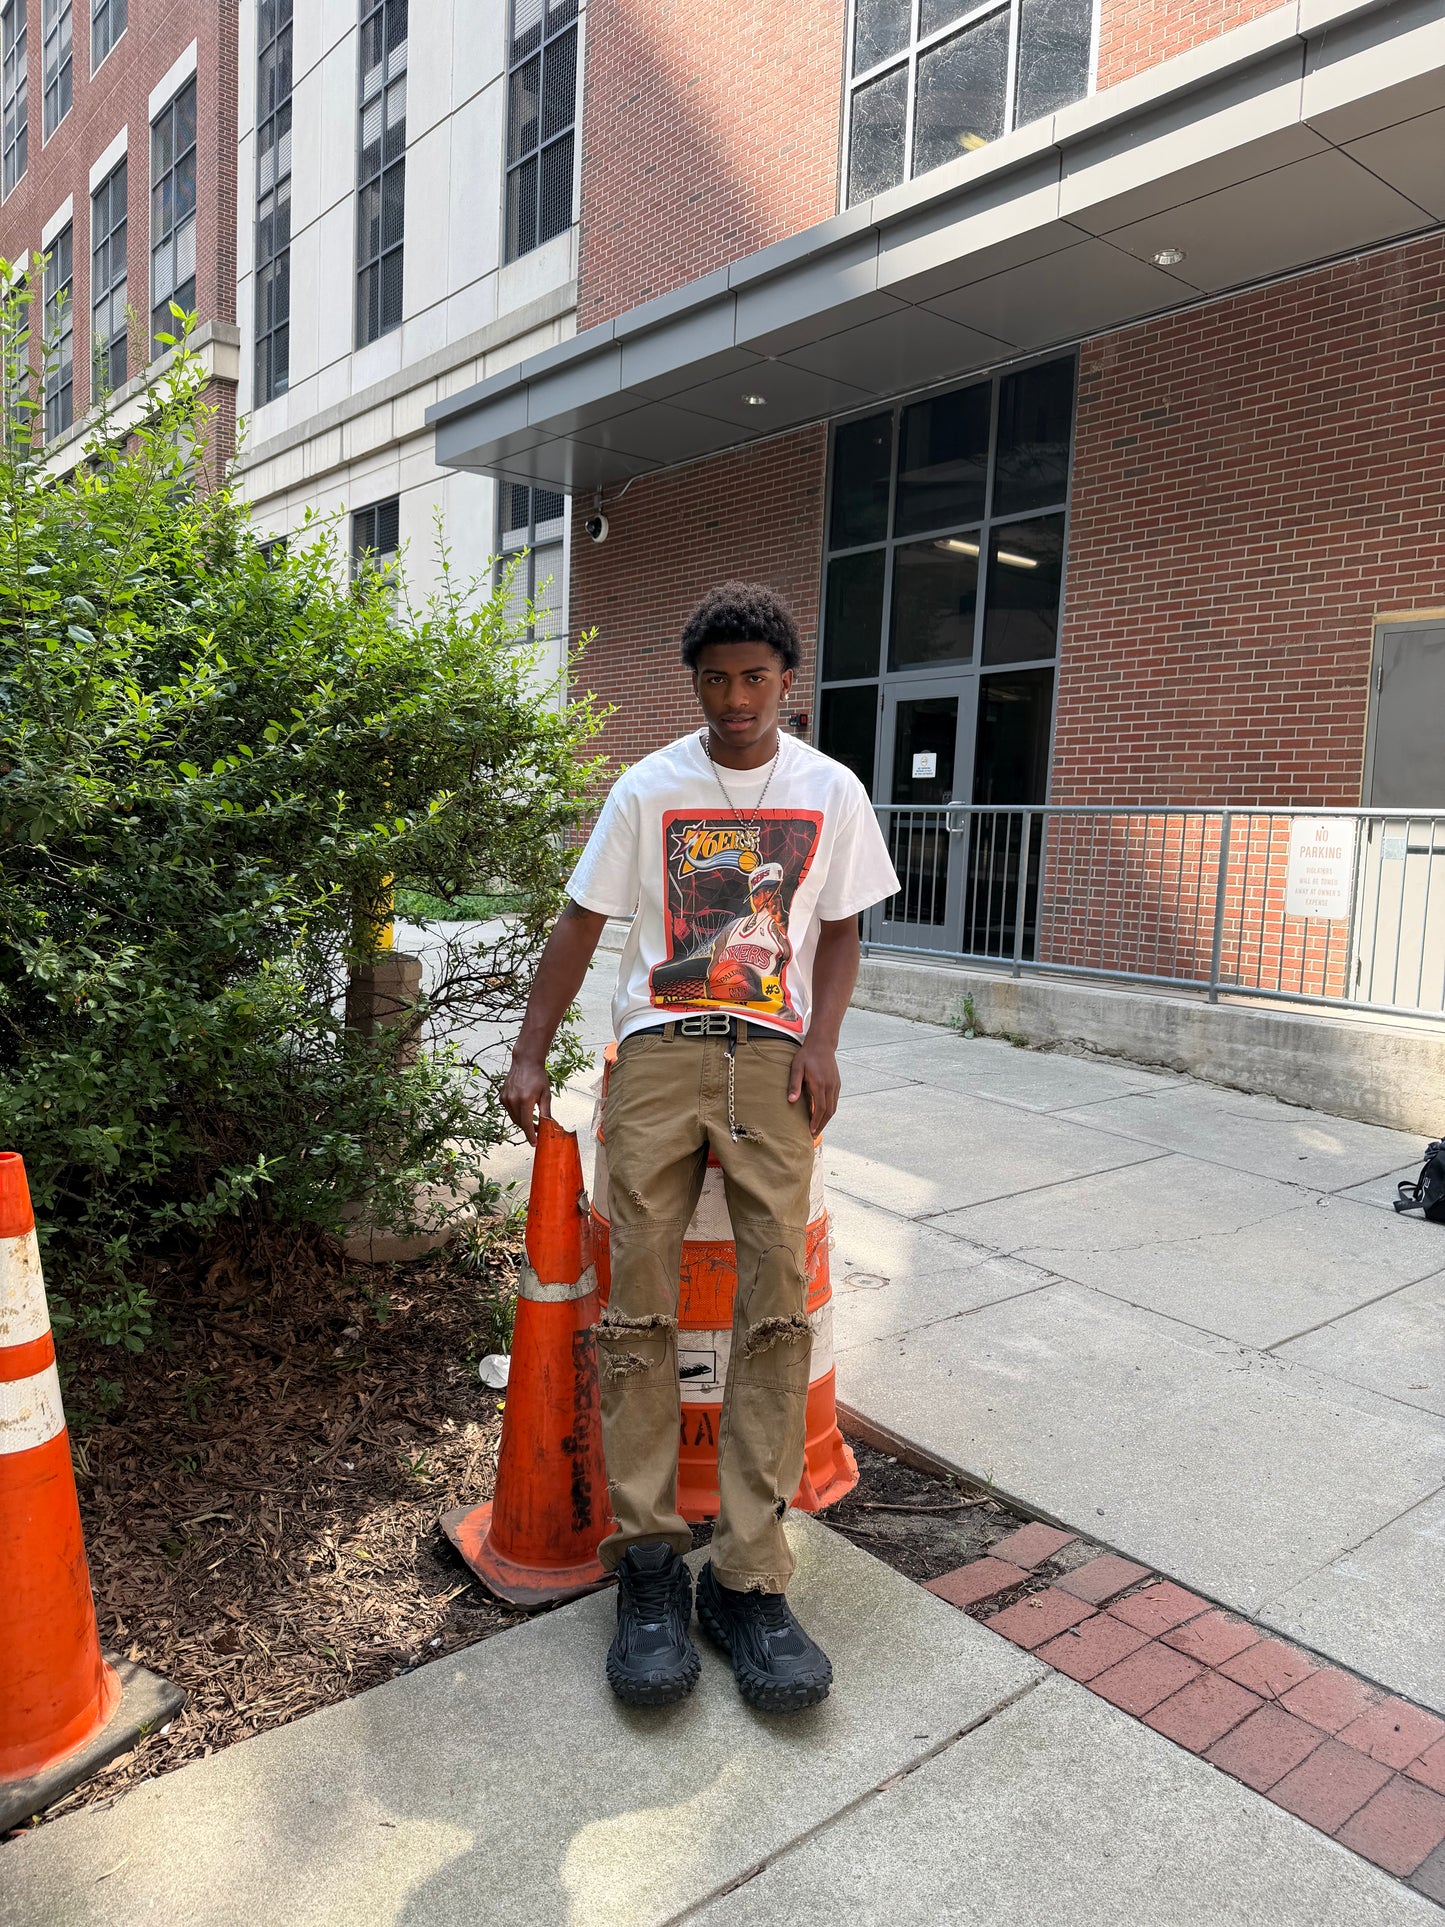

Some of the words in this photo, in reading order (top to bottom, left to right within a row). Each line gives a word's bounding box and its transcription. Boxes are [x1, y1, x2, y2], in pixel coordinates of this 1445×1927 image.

[1315, 829, 1329, 842] NO
[1300, 846, 1342, 859] PARKING
[1295, 887, 1309, 895] AWAY
[1305, 898, 1328, 906] EXPENSE
[765, 984, 780, 995] #3
